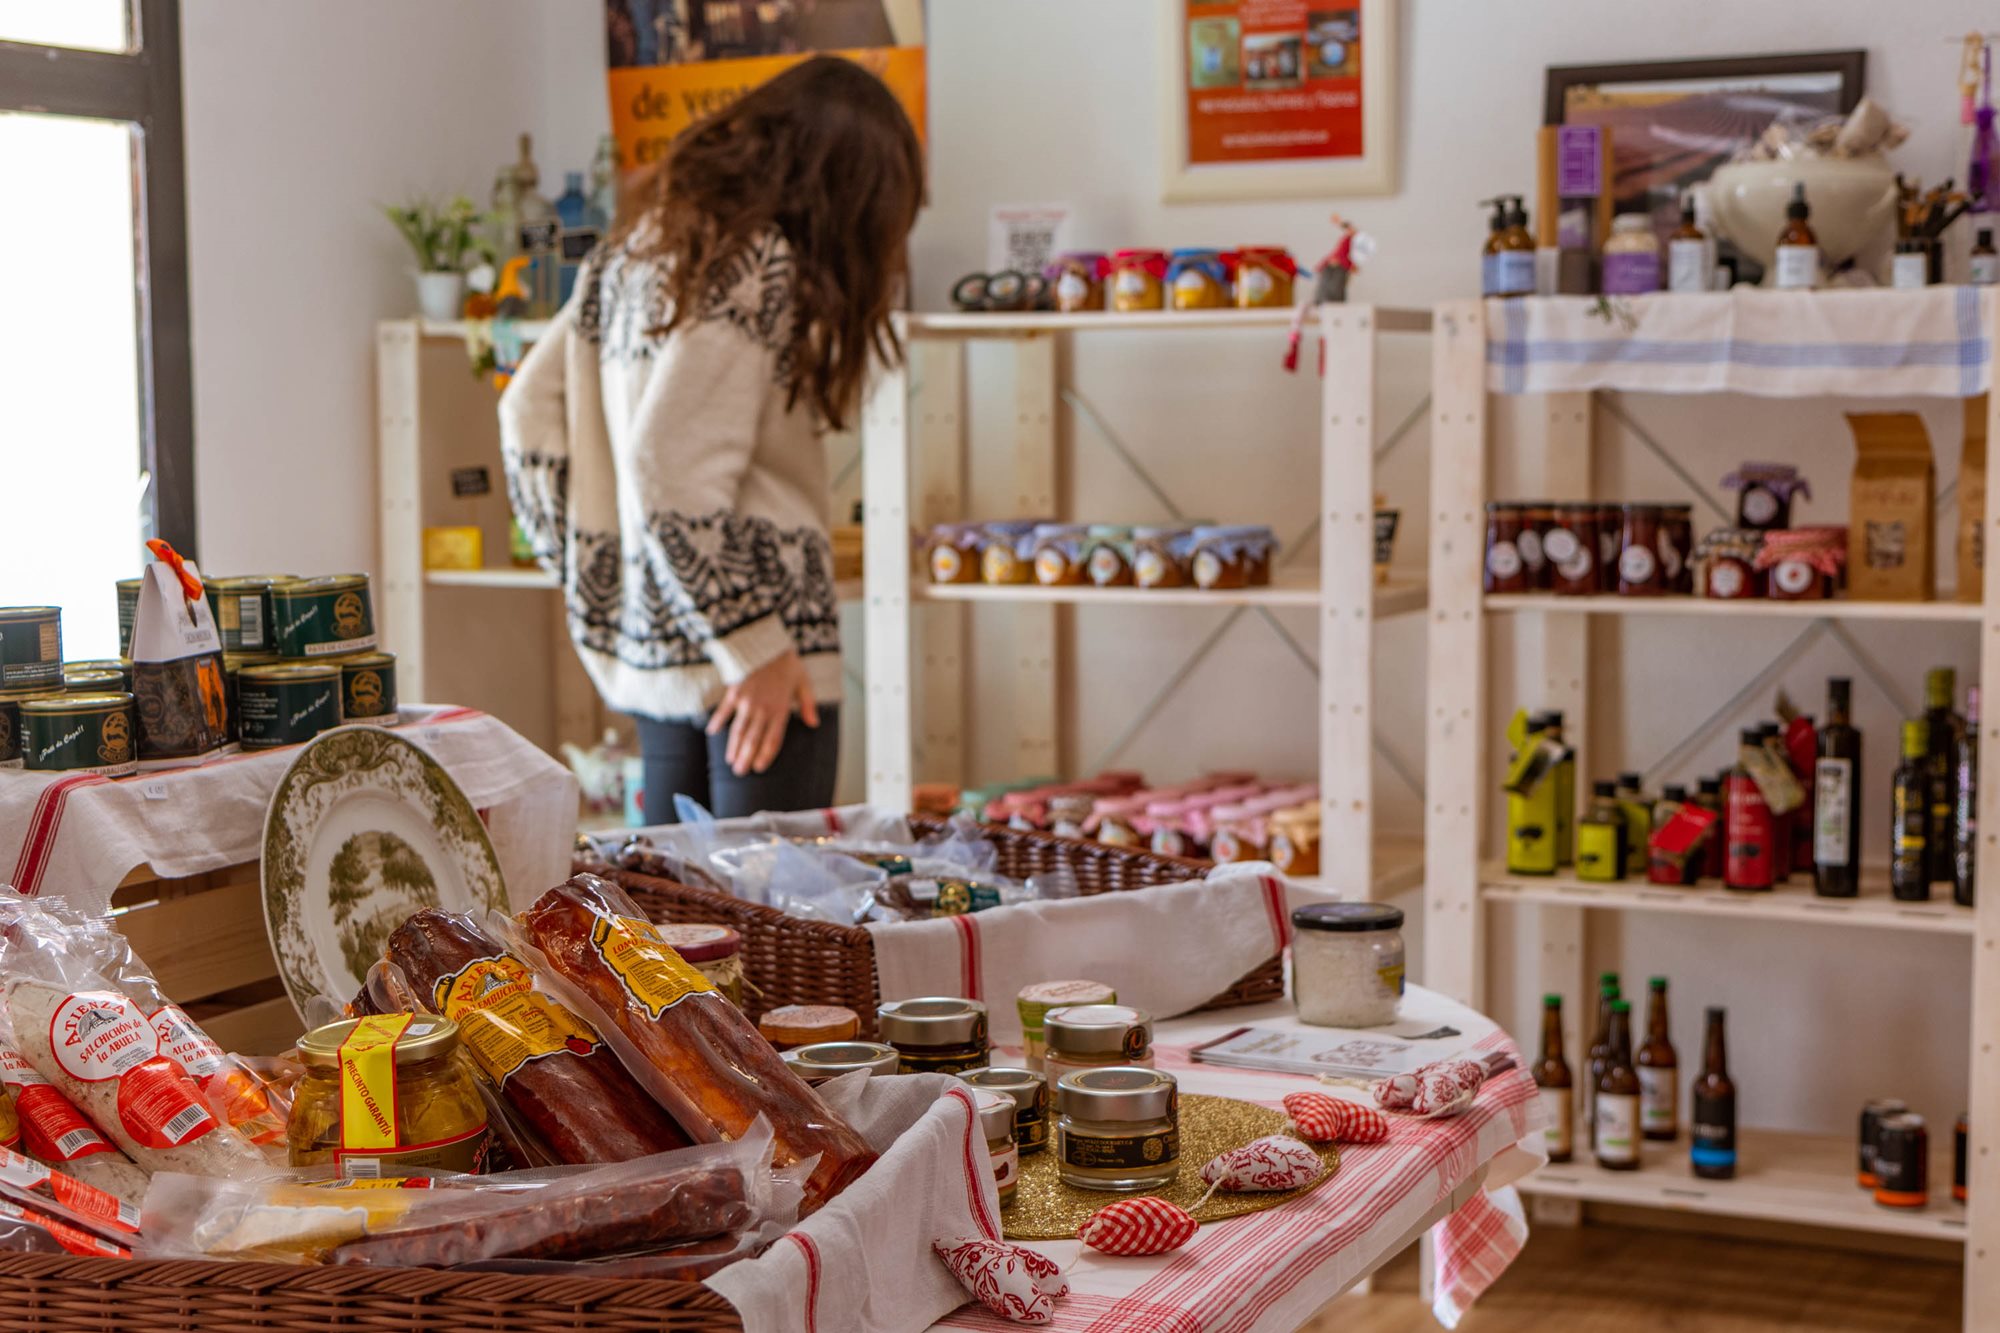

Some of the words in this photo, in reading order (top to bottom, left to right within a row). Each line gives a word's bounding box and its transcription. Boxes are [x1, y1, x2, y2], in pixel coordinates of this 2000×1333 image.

[630, 80, 670, 122] de
[478, 981, 532, 1009] EMBUCHADO
[65, 1001, 125, 1047] ATIENZA
[80, 1022, 133, 1064] SALCHICHÓN
[133, 1019, 142, 1029] de
[96, 1051, 108, 1064] la
[109, 1031, 142, 1055] ABUELA
[344, 1058, 370, 1098] PRECINTO
[364, 1096, 393, 1138] GARANTÍA
